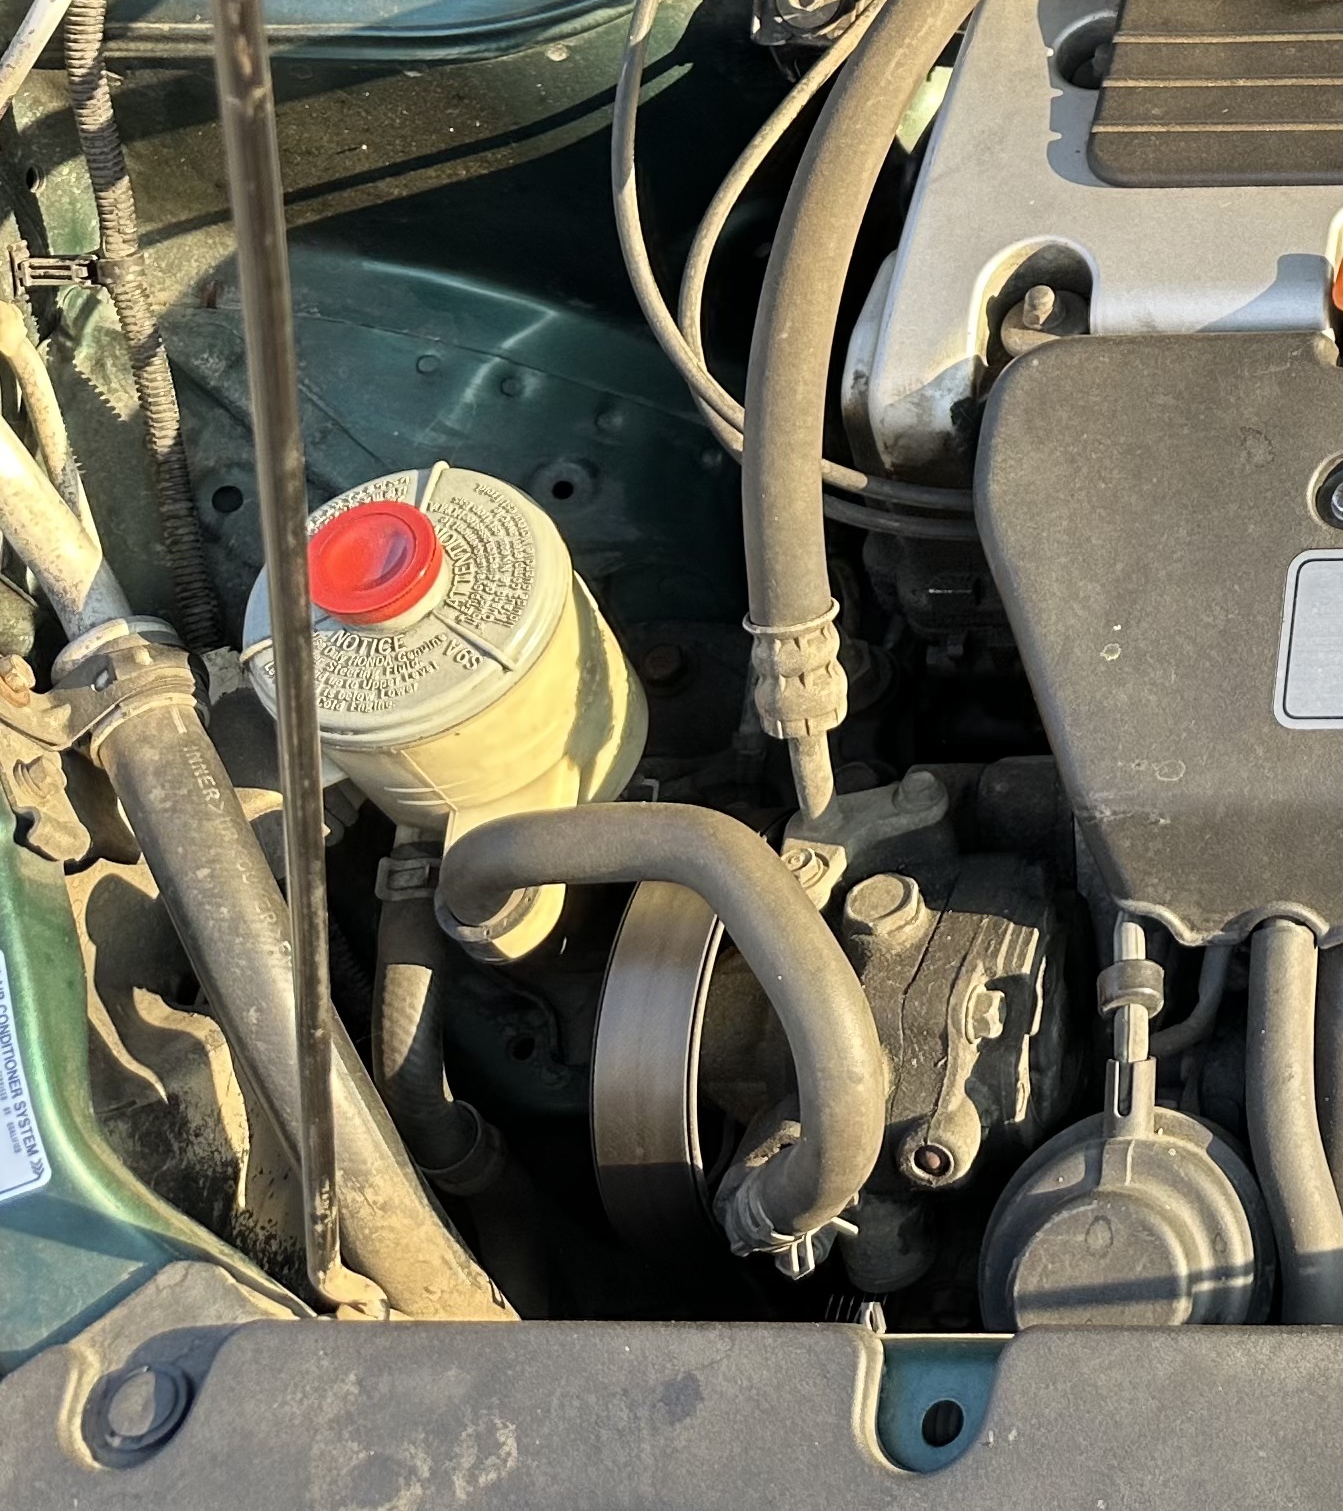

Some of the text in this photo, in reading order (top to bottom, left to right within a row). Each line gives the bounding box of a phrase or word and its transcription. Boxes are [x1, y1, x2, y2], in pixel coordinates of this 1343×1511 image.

[434, 524, 474, 609] ATTENTION
[331, 630, 407, 656] NOTICE
[348, 654, 395, 668] HONDA
[13, 1099, 40, 1158] SYSTEM
